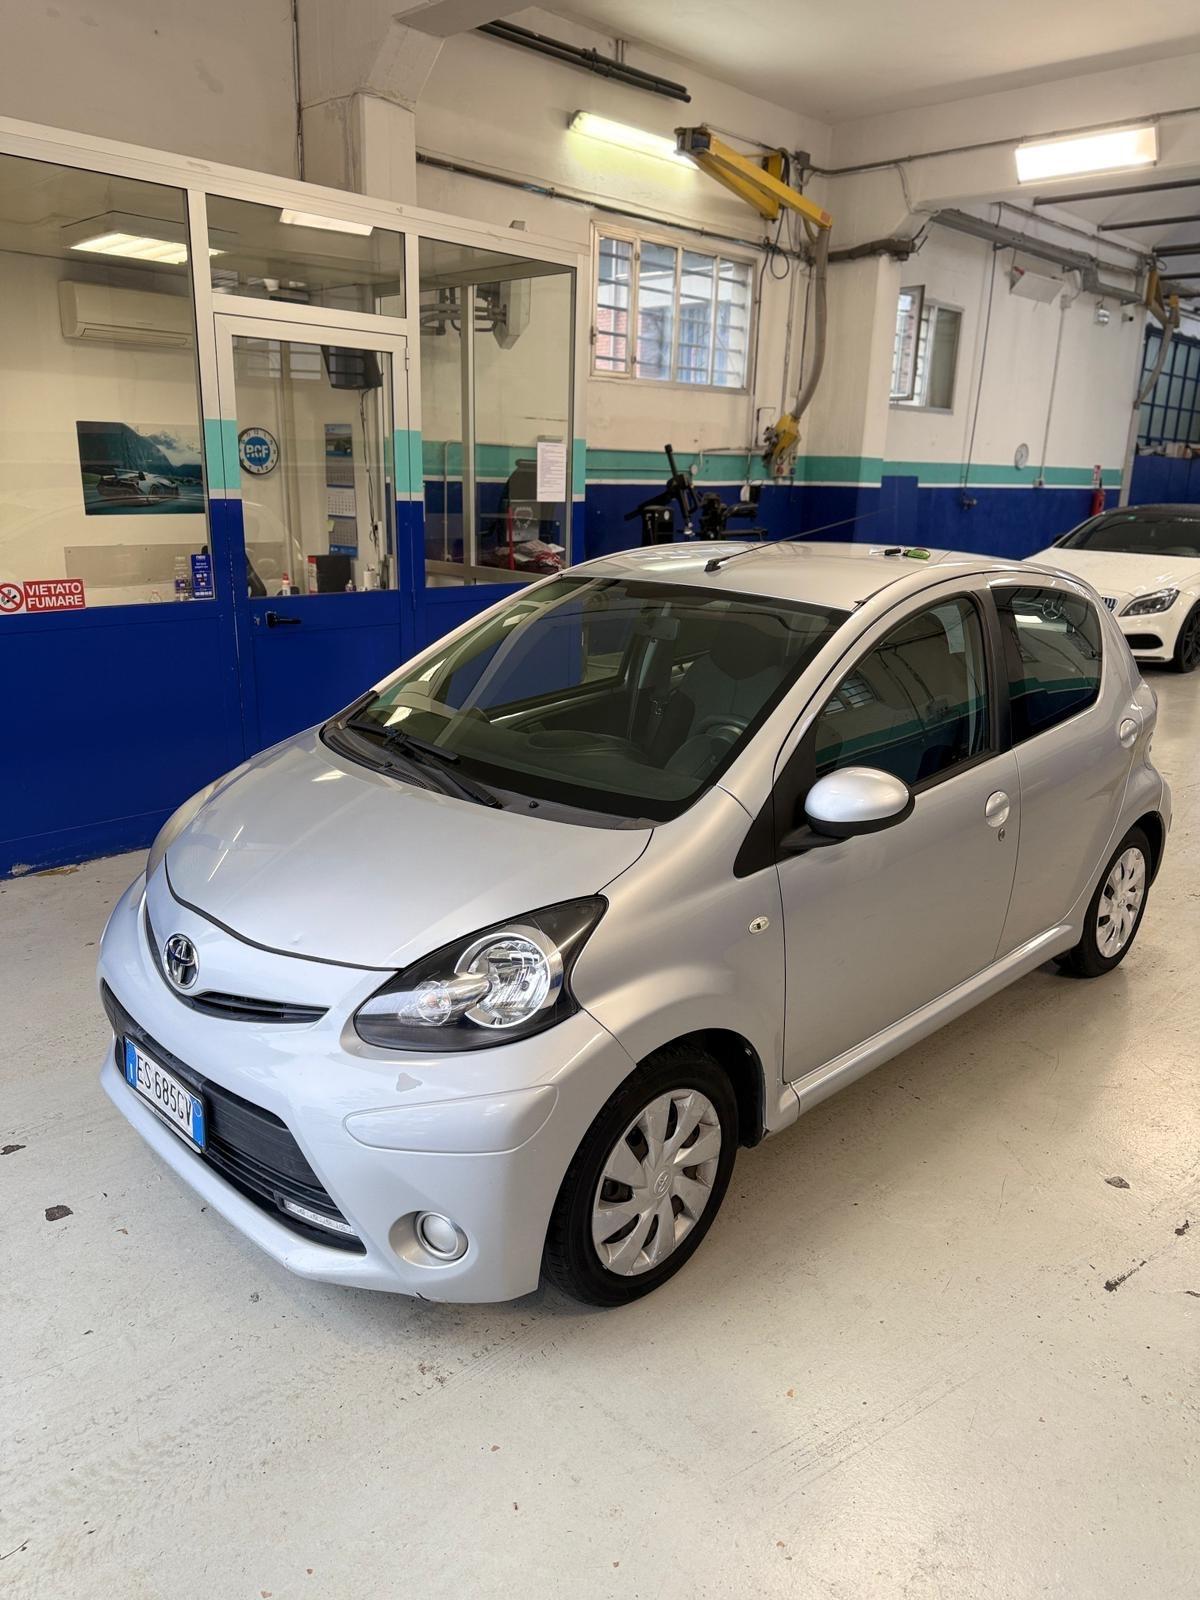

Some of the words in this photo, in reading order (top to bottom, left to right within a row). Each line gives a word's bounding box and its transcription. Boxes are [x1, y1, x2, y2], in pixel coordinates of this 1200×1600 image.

[26, 582, 82, 596] VIETATO
[27, 595, 84, 609] FUMARE
[137, 1055, 152, 1090] ES
